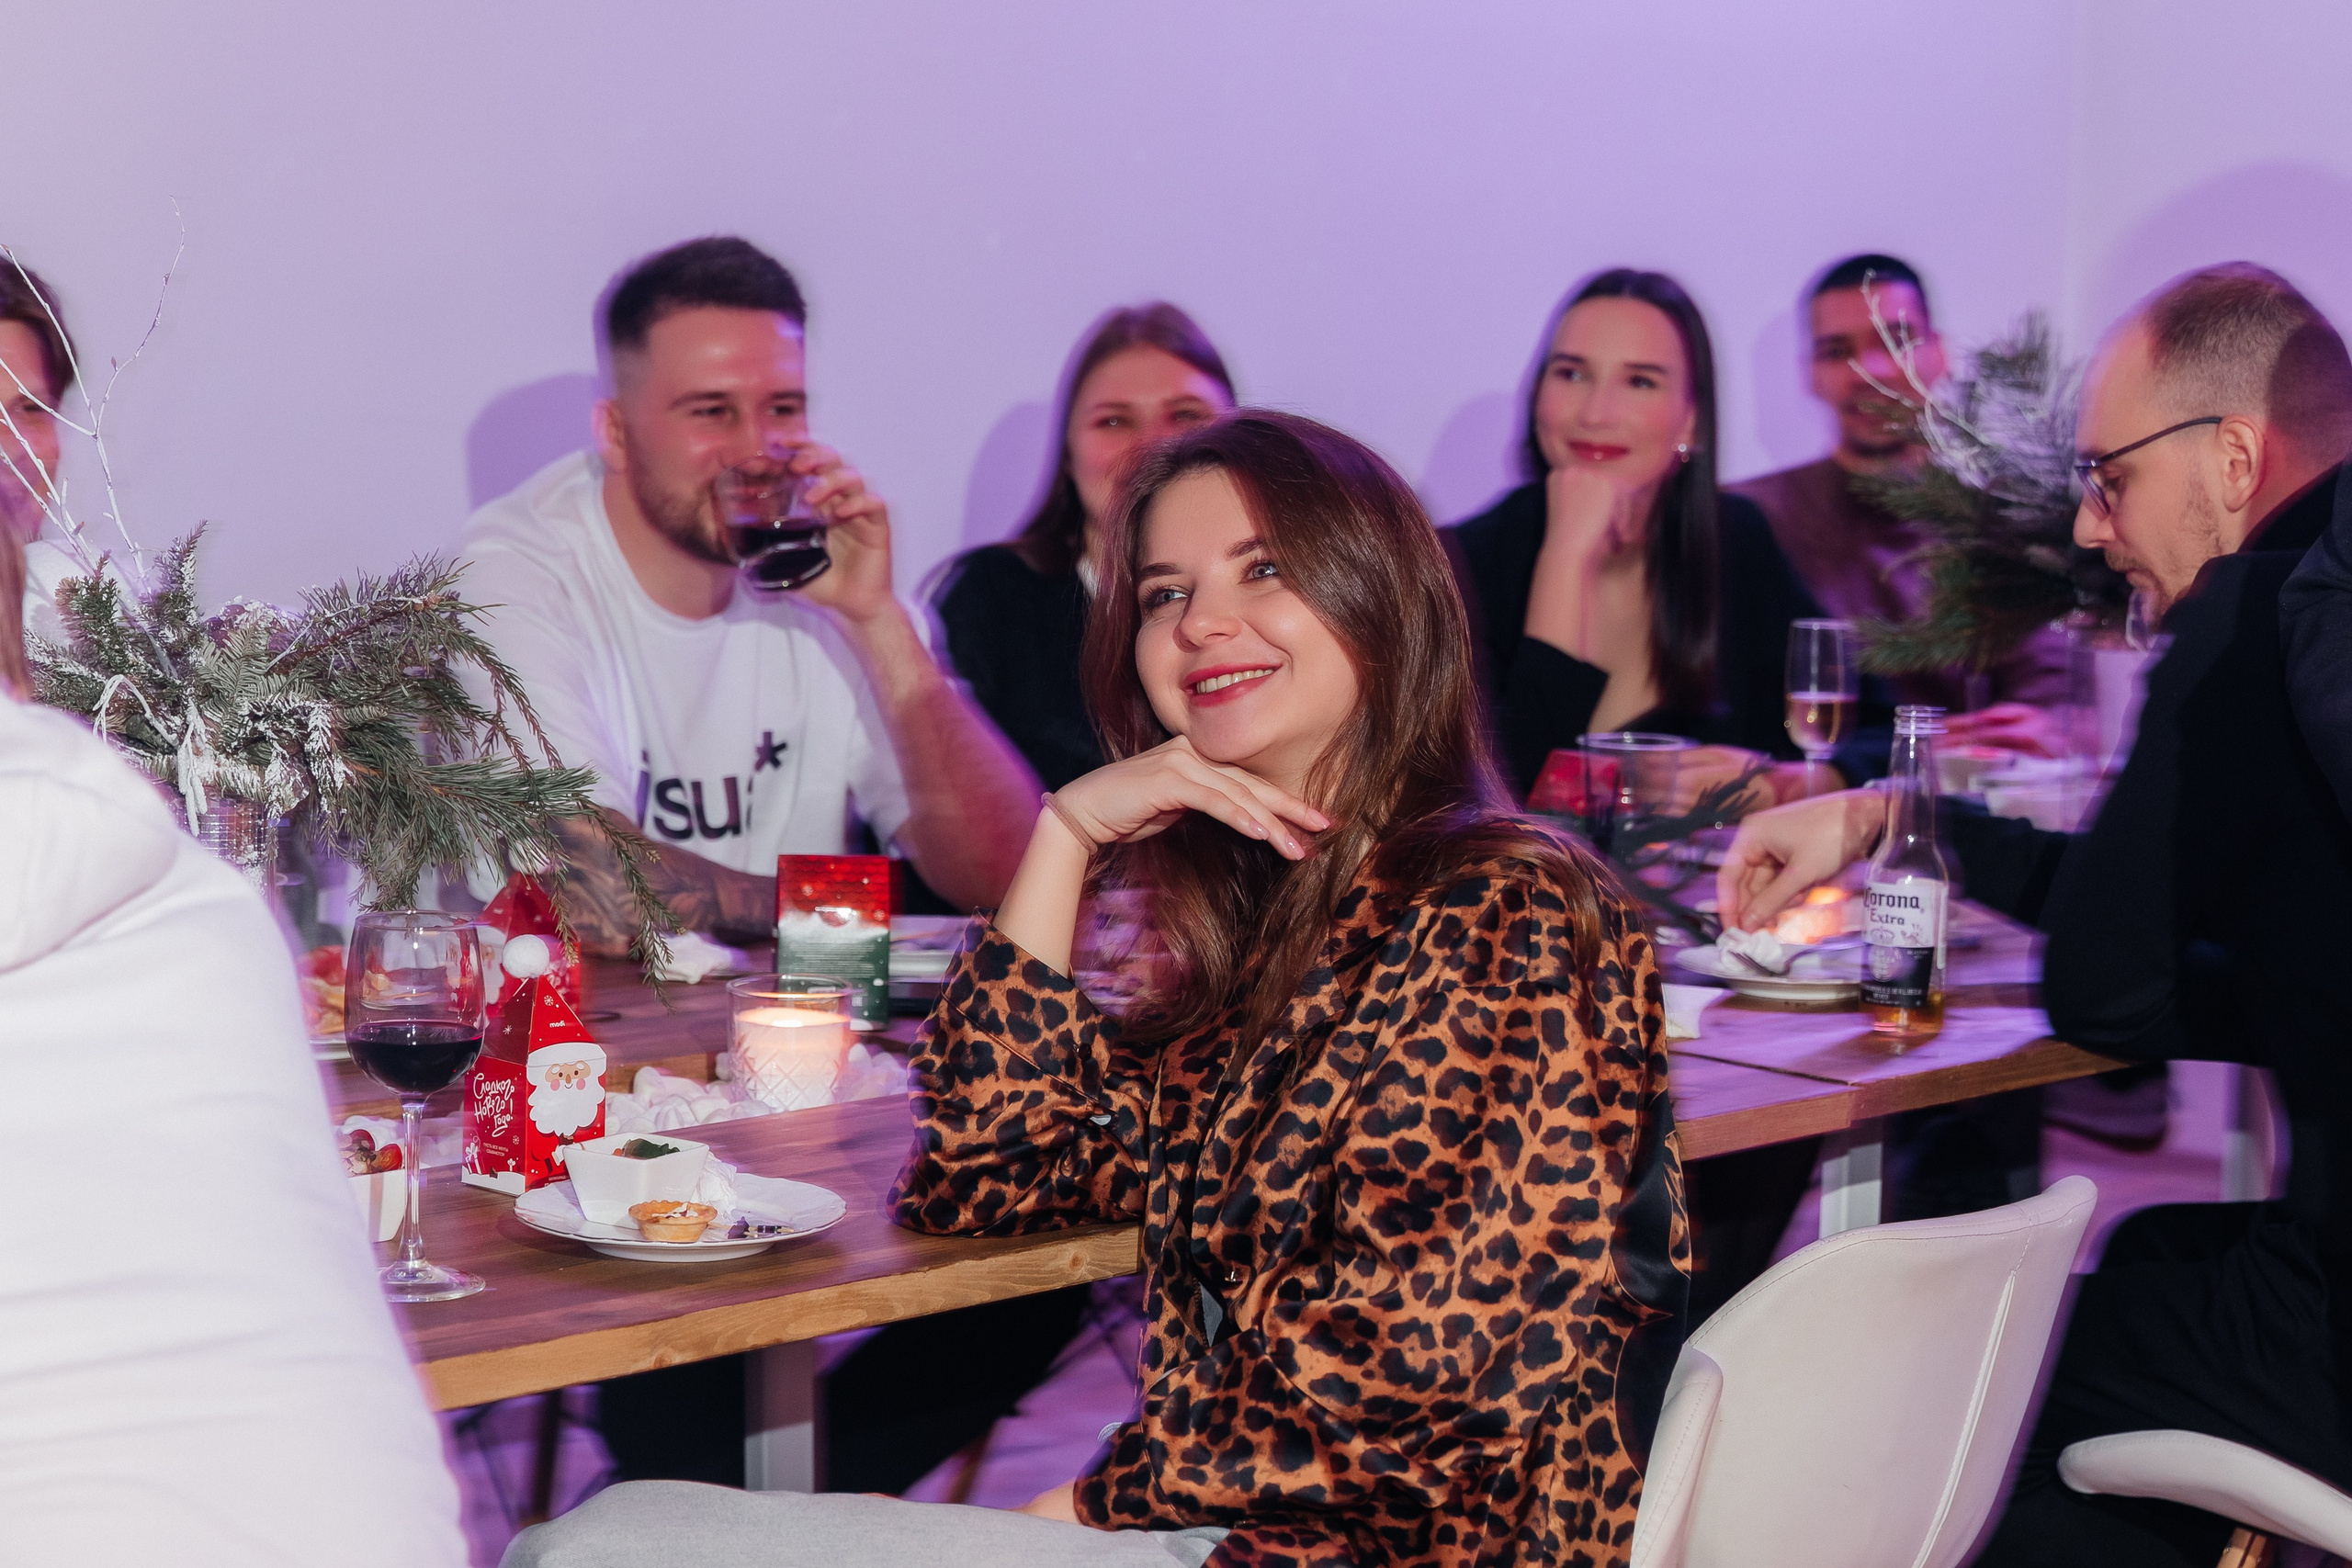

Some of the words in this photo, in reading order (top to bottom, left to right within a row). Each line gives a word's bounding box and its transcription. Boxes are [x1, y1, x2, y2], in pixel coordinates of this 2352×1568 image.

[1863, 886, 1919, 908] Corona
[1870, 908, 1905, 925] Extra
[473, 1072, 514, 1101] Сладкого
